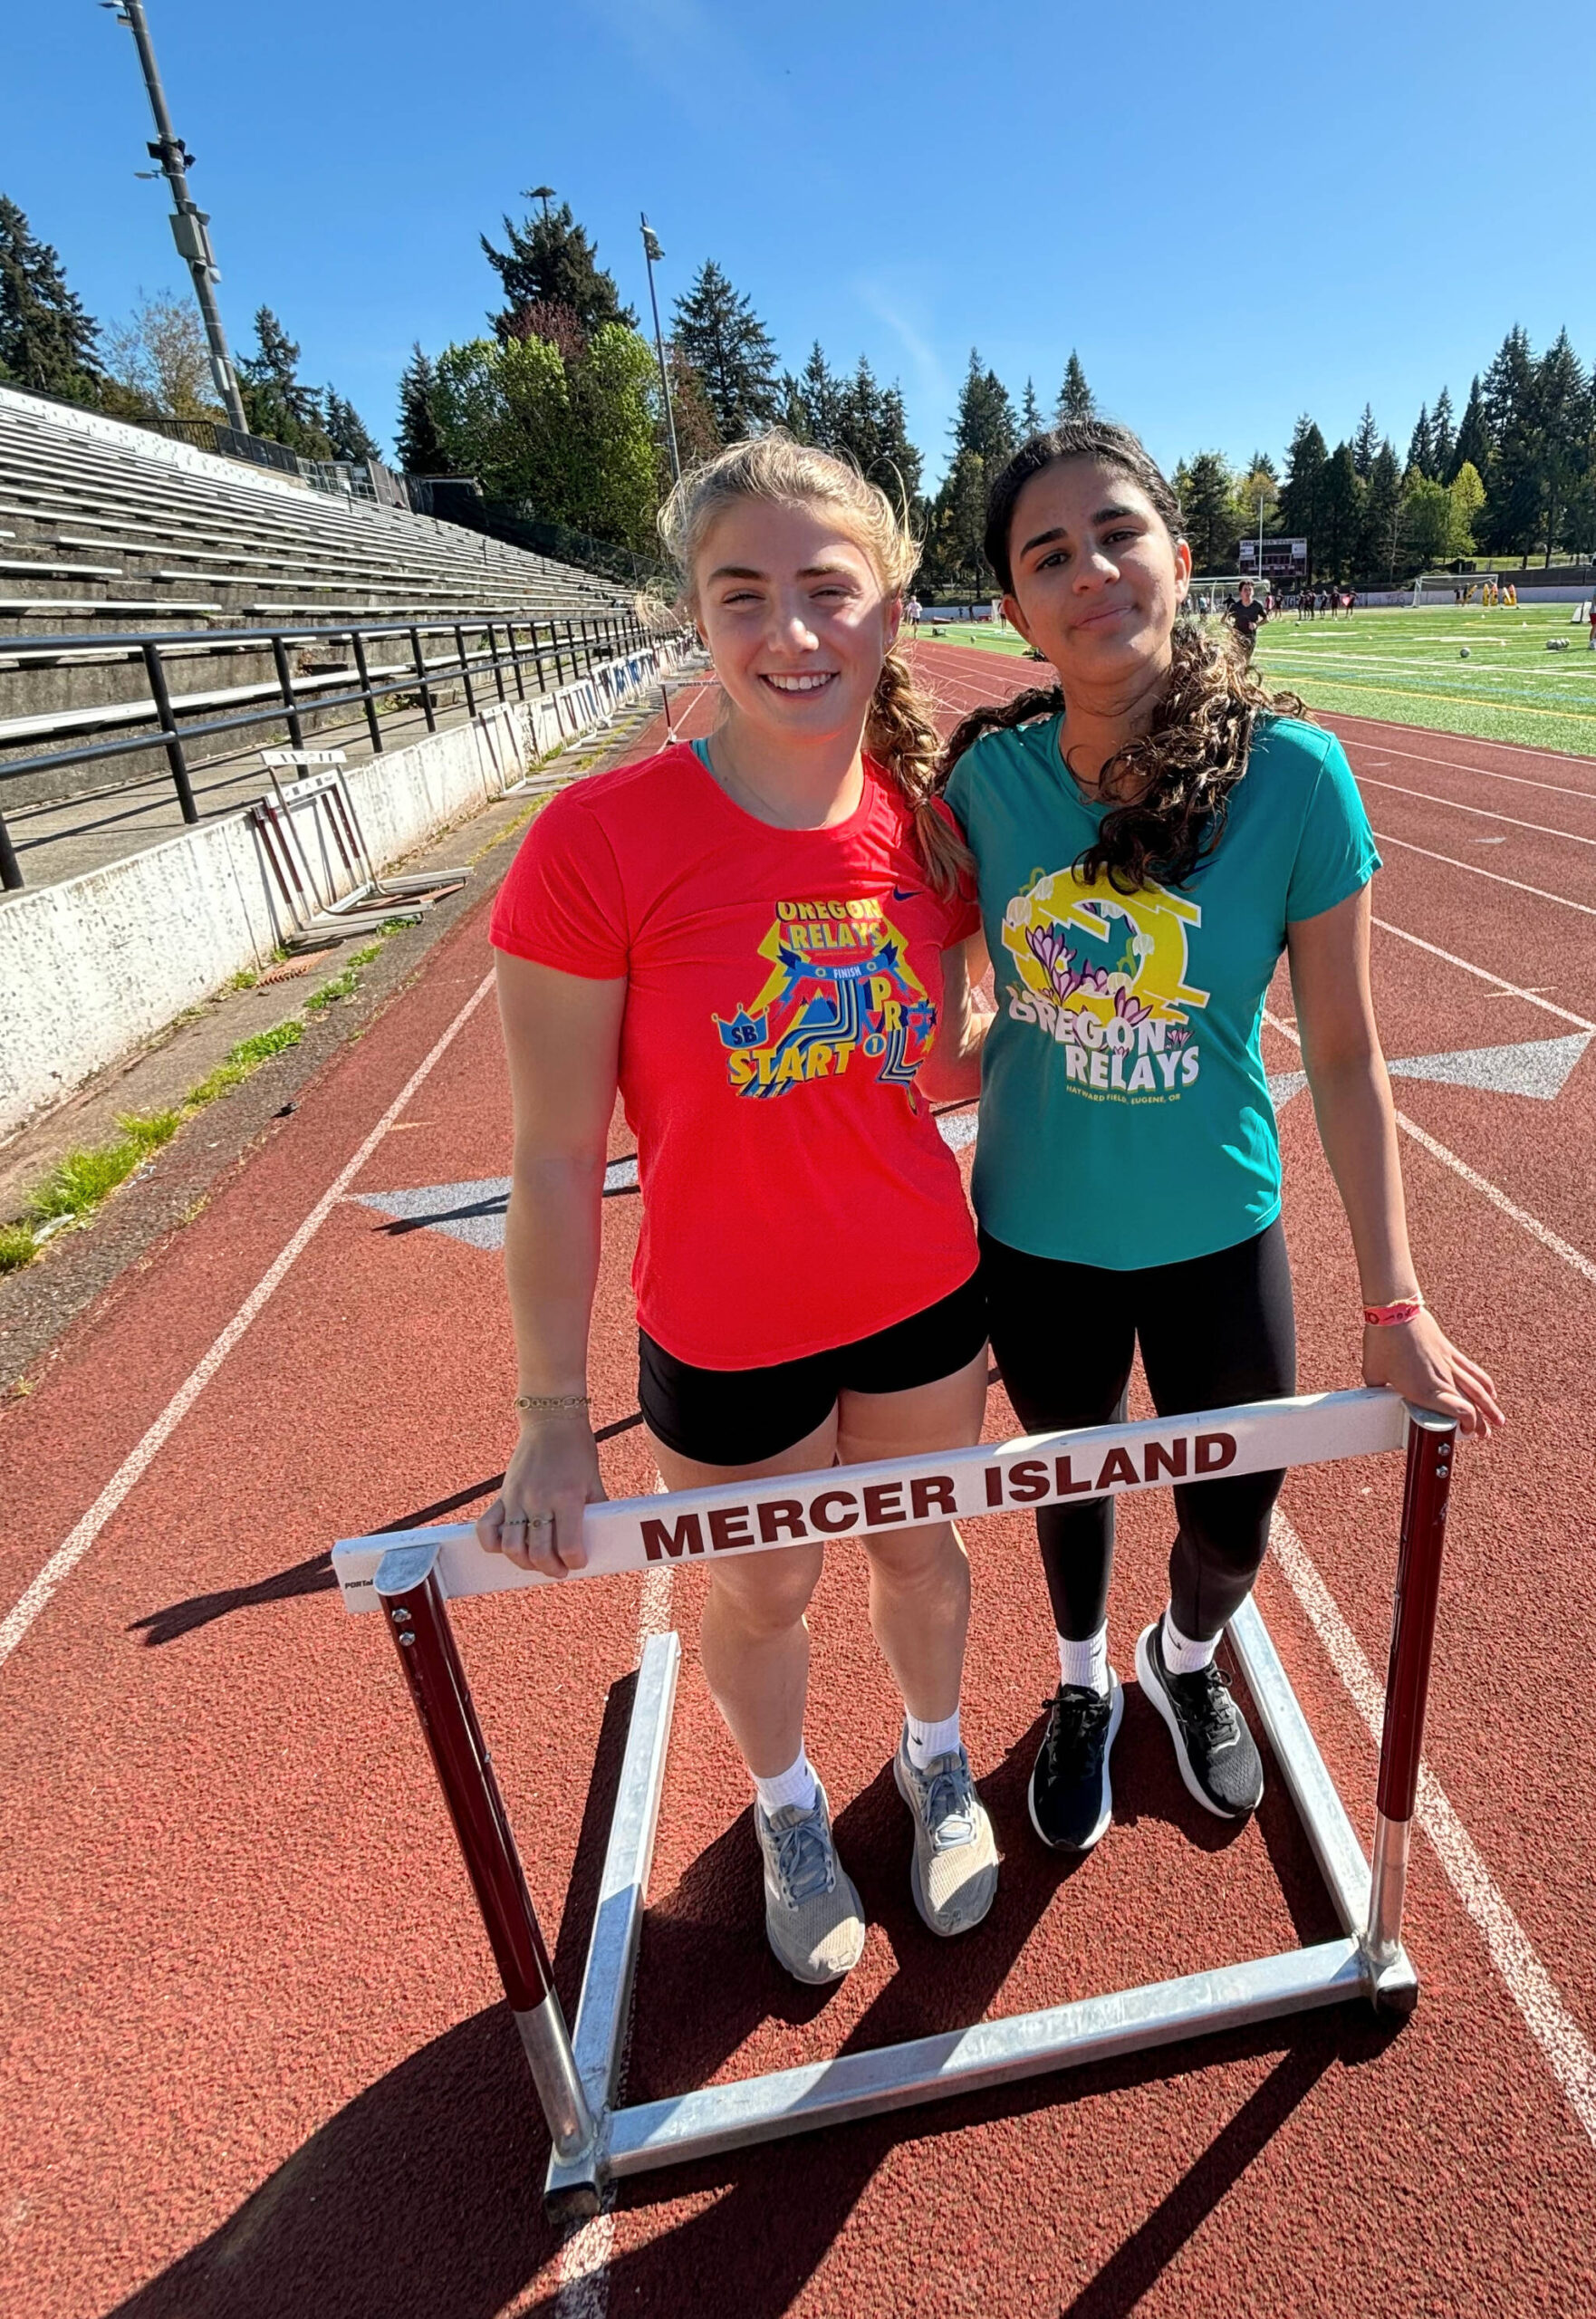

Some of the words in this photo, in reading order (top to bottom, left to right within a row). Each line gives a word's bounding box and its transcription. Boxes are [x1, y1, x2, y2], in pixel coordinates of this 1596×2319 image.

[777, 899, 883, 921] OREGON
[788, 922, 883, 950] RELAYS
[832, 966, 861, 980] FINISH
[730, 1025, 758, 1044] SB
[1008, 996, 1168, 1054] OREGON
[728, 1042, 856, 1085] START
[1065, 1045, 1199, 1092] RELAYS
[1066, 1084, 1105, 1102] HAYWARD
[1168, 1092, 1181, 1102] OR
[639, 1476, 958, 1562] MERCER
[985, 1432, 1237, 1507] ISLAND
